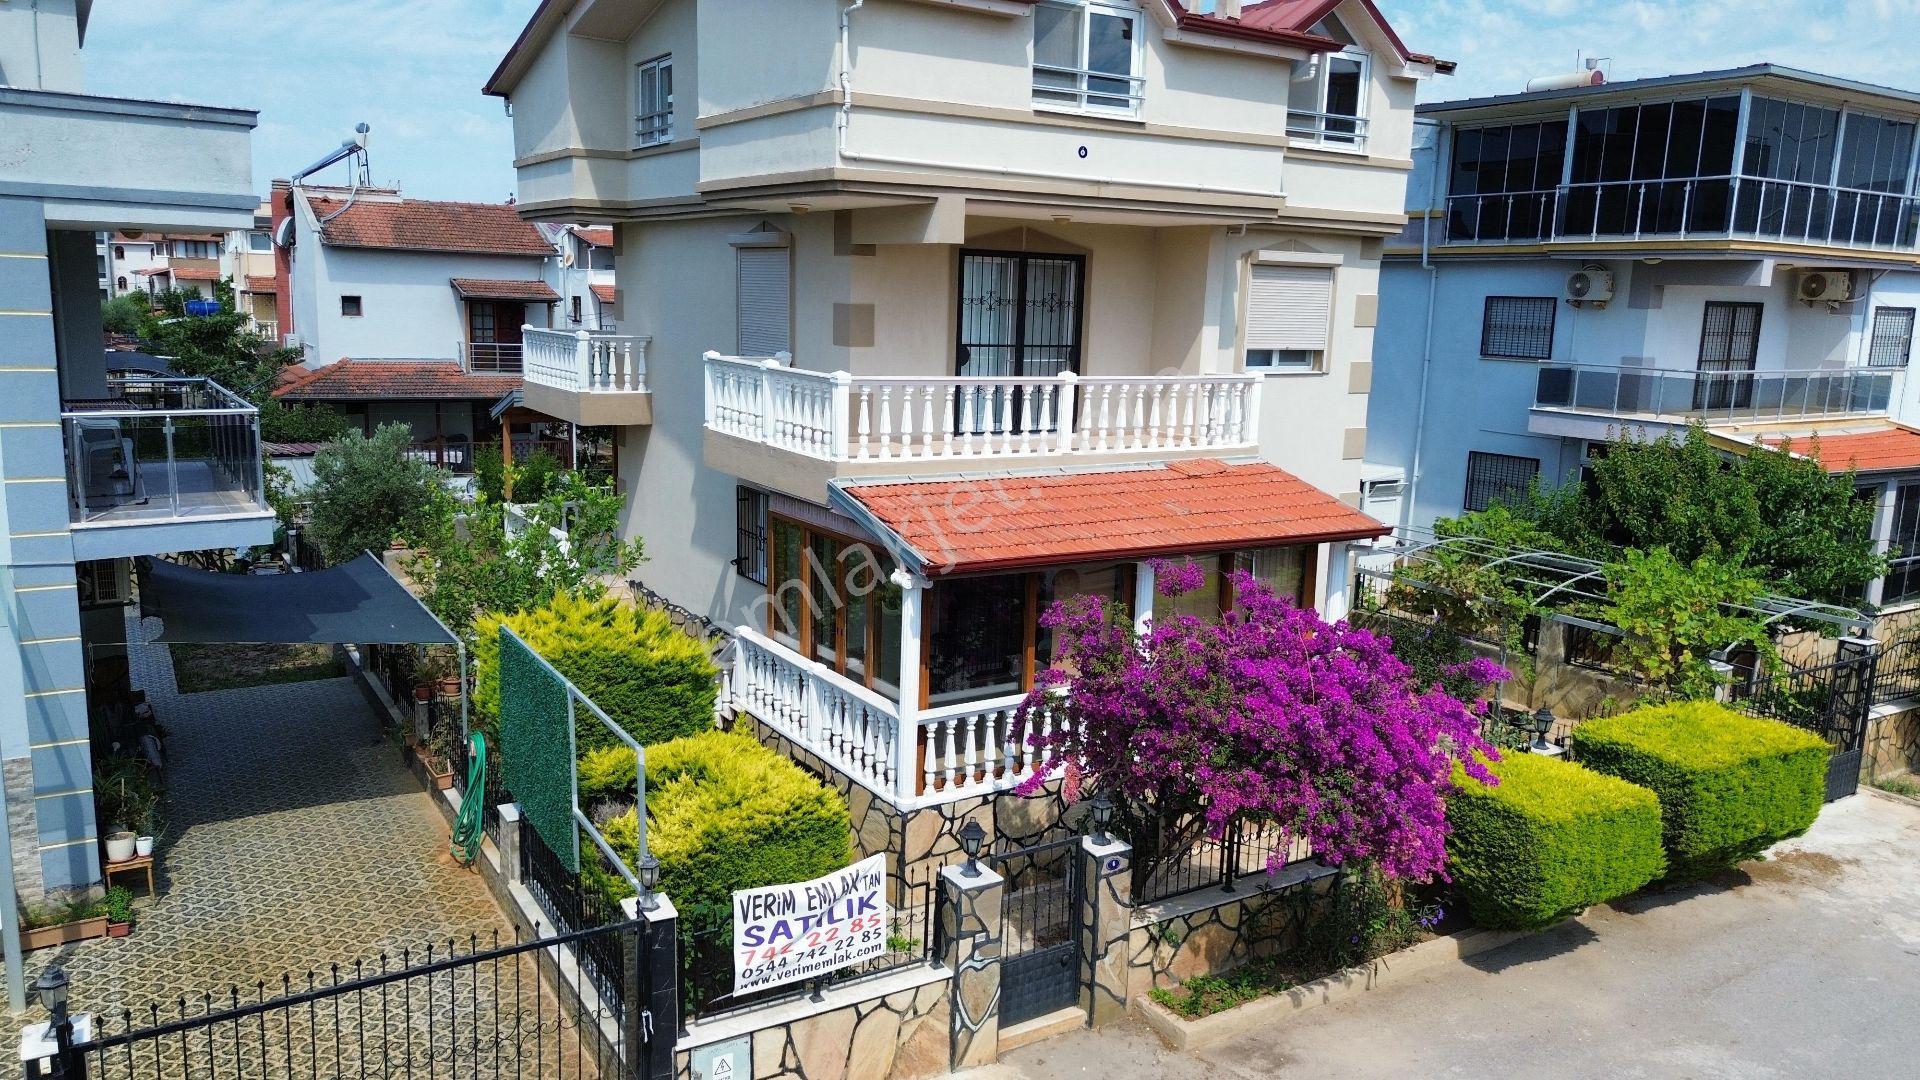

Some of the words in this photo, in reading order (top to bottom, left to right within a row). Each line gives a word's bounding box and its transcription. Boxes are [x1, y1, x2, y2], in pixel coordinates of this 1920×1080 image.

[741, 942, 794, 966] 742
[805, 927, 839, 947] 22
[850, 913, 881, 933] 85
[742, 891, 878, 948] SATILIK
[740, 942, 882, 990] www.verimemlak.com
[742, 957, 788, 979] 0544
[796, 945, 827, 963] 742
[835, 936, 855, 951] 22
[862, 927, 882, 943] 85
